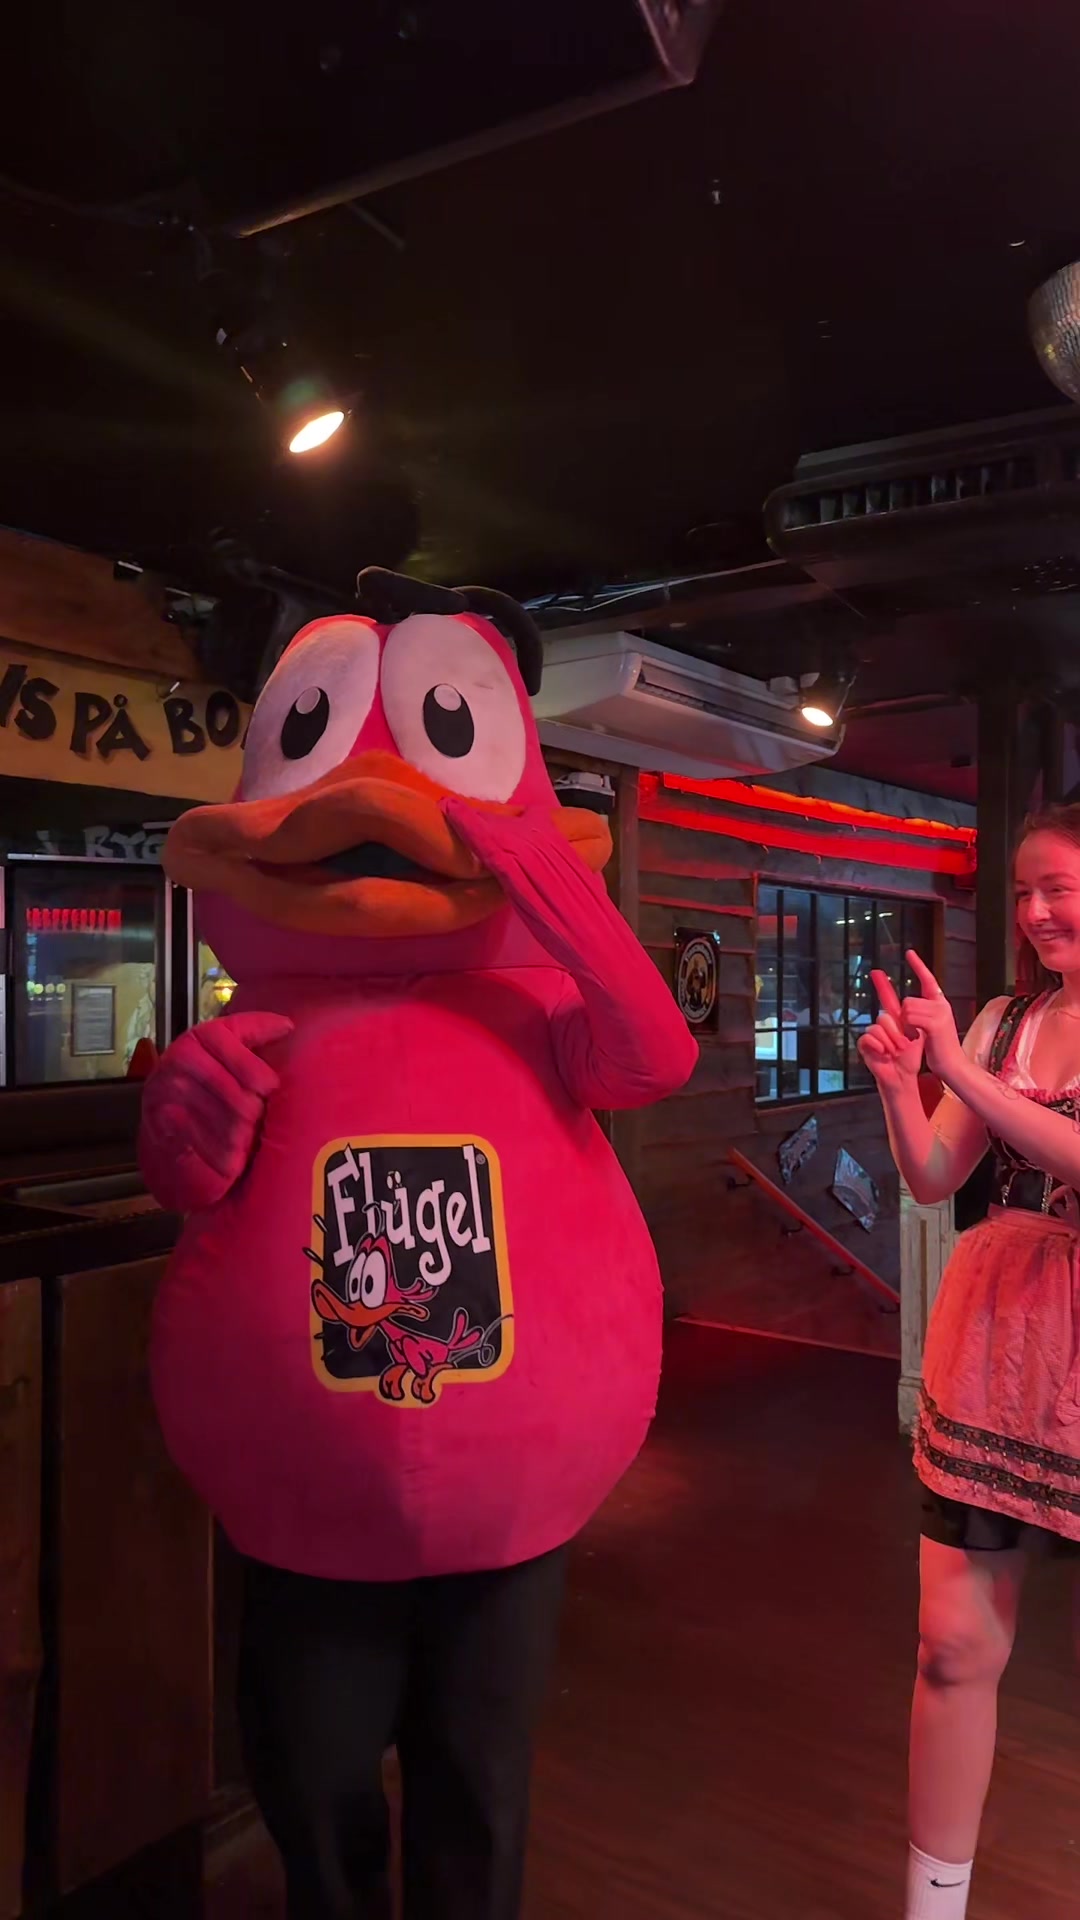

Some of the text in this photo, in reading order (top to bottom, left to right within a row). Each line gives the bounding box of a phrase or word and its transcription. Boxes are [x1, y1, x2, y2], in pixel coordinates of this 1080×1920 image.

[70, 692, 150, 761] PÅ
[163, 691, 247, 755] BO
[327, 1144, 491, 1286] Flügel
